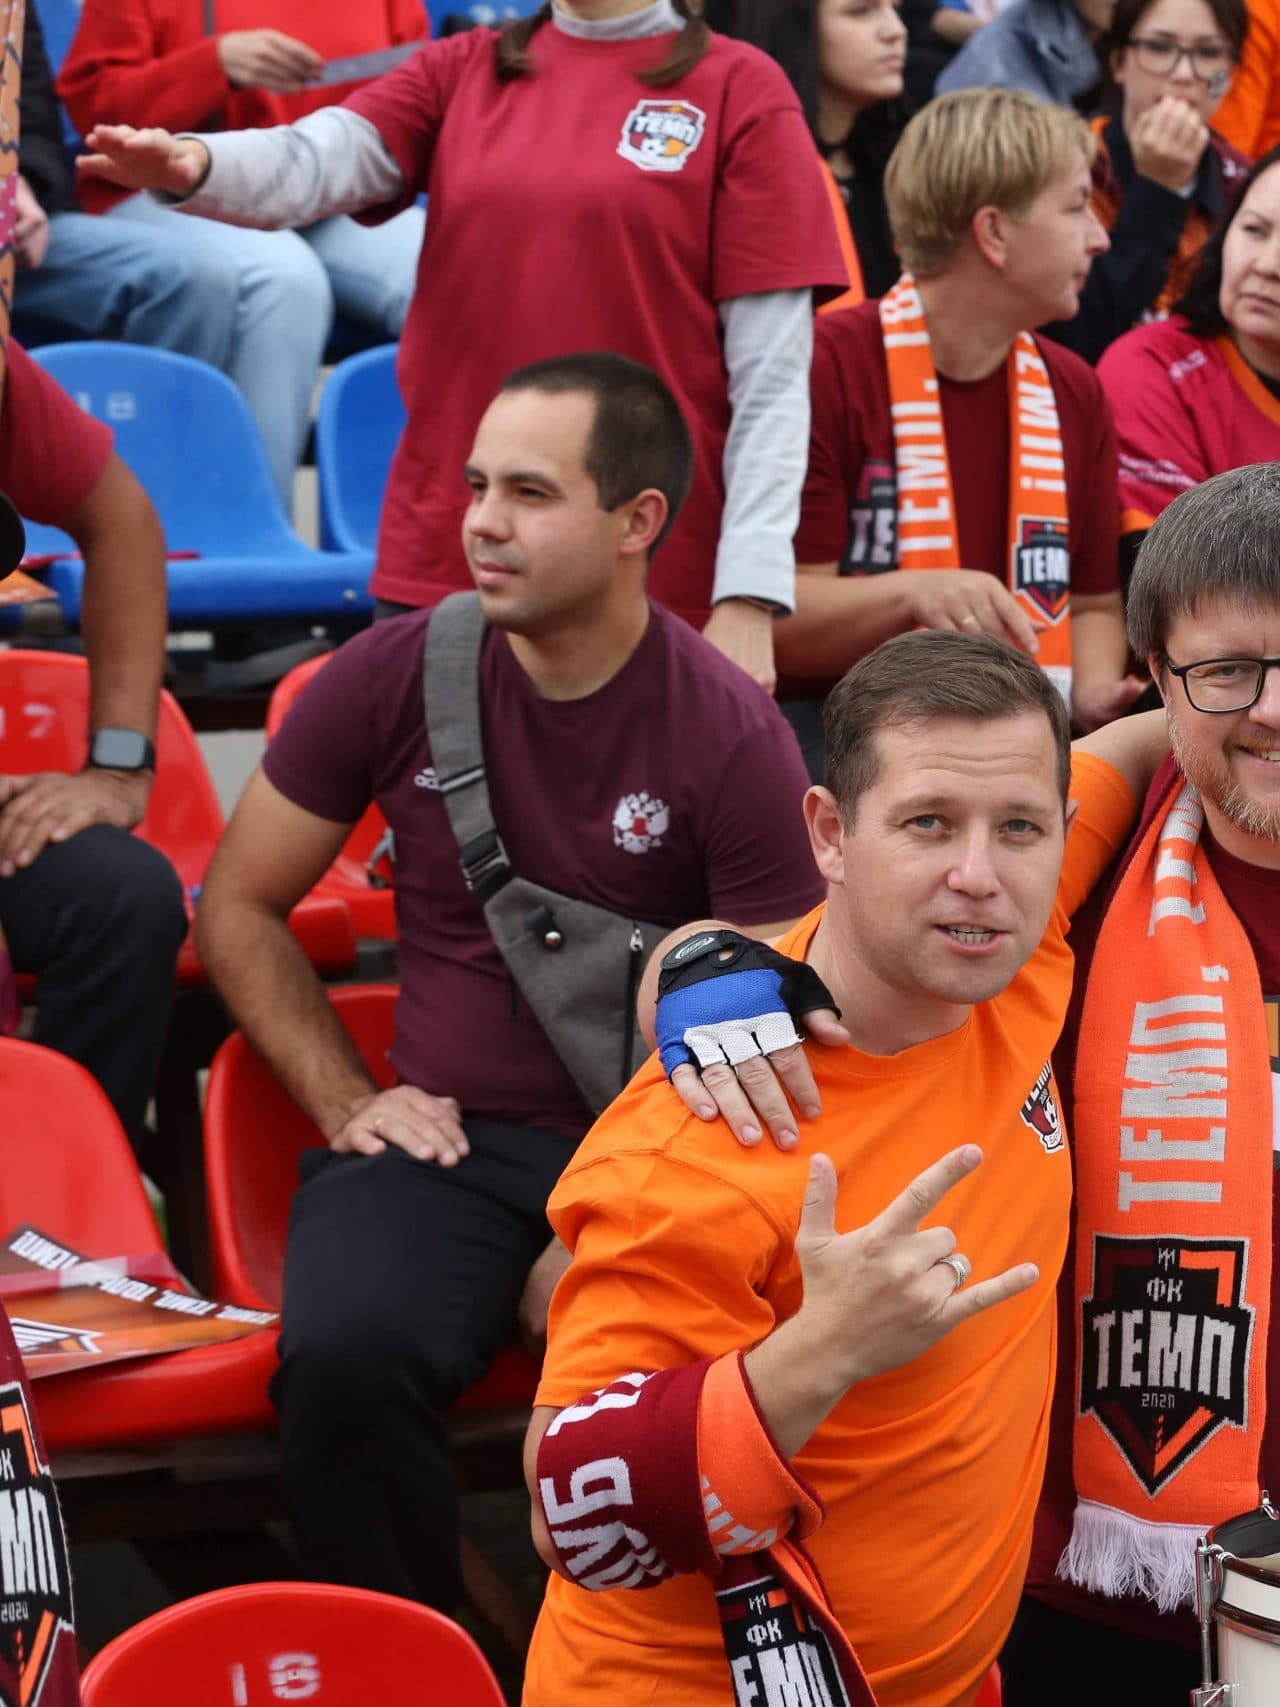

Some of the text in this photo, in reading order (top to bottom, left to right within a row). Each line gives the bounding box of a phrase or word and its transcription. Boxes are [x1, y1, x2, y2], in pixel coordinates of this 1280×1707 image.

[1146, 1277, 1183, 1303] ФК
[1093, 1309, 1236, 1400] ТЕМП
[1141, 1393, 1176, 1409] 2020
[0, 1486, 61, 1596] МП
[745, 1617, 783, 1647] ФК
[729, 1641, 836, 1707] ЕМП
